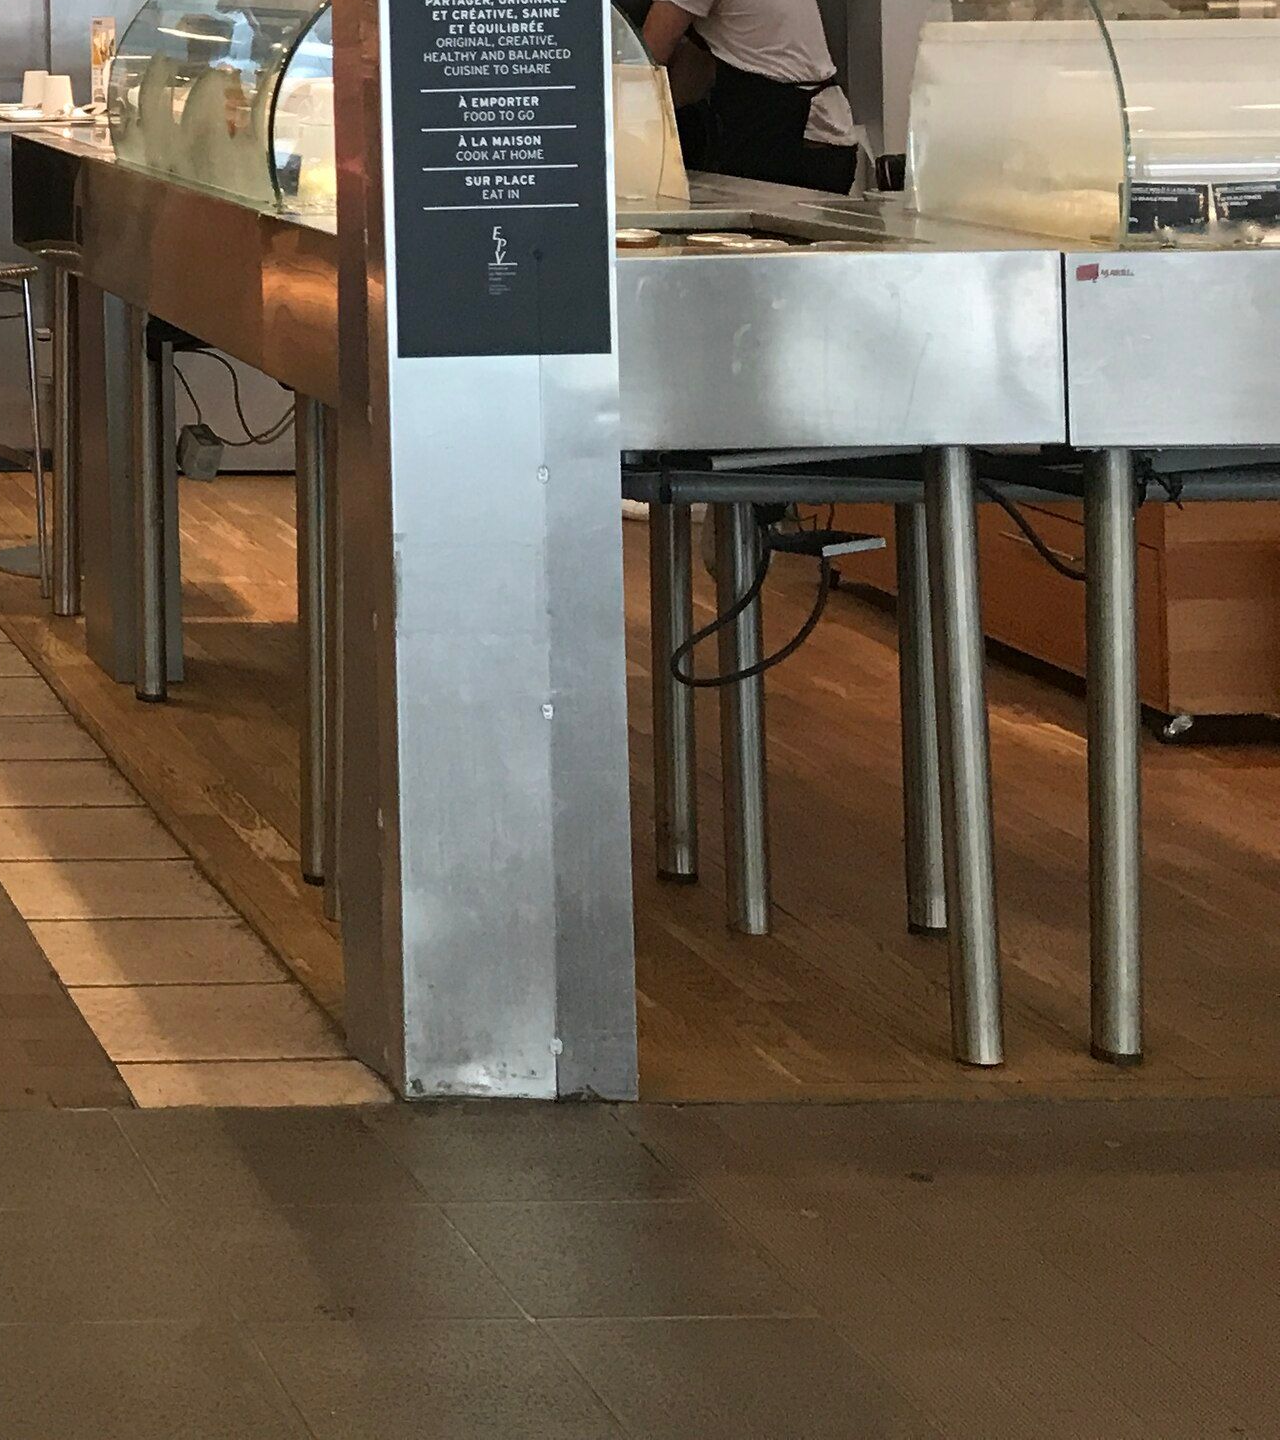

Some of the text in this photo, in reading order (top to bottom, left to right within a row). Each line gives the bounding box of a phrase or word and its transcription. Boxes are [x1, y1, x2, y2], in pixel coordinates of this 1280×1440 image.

[432, 7, 560, 21] ET CRÉATIVE, SAINE
[449, 20, 545, 35] ET ÉQUILIBRÉE
[436, 34, 557, 48] ORIGINAL, CREATIVE,
[423, 48, 571, 62] HEALTHY AND BALANCED
[443, 63, 551, 76] CUISINE TO SHARE
[458, 95, 539, 108] À EMPORTER
[463, 109, 535, 122] FOOD TO GO
[458, 134, 541, 147] À LA MAISON
[456, 149, 544, 161] COOK AT HOME
[465, 175, 535, 186] SUR PLACE
[482, 188, 520, 200] EAT IN
